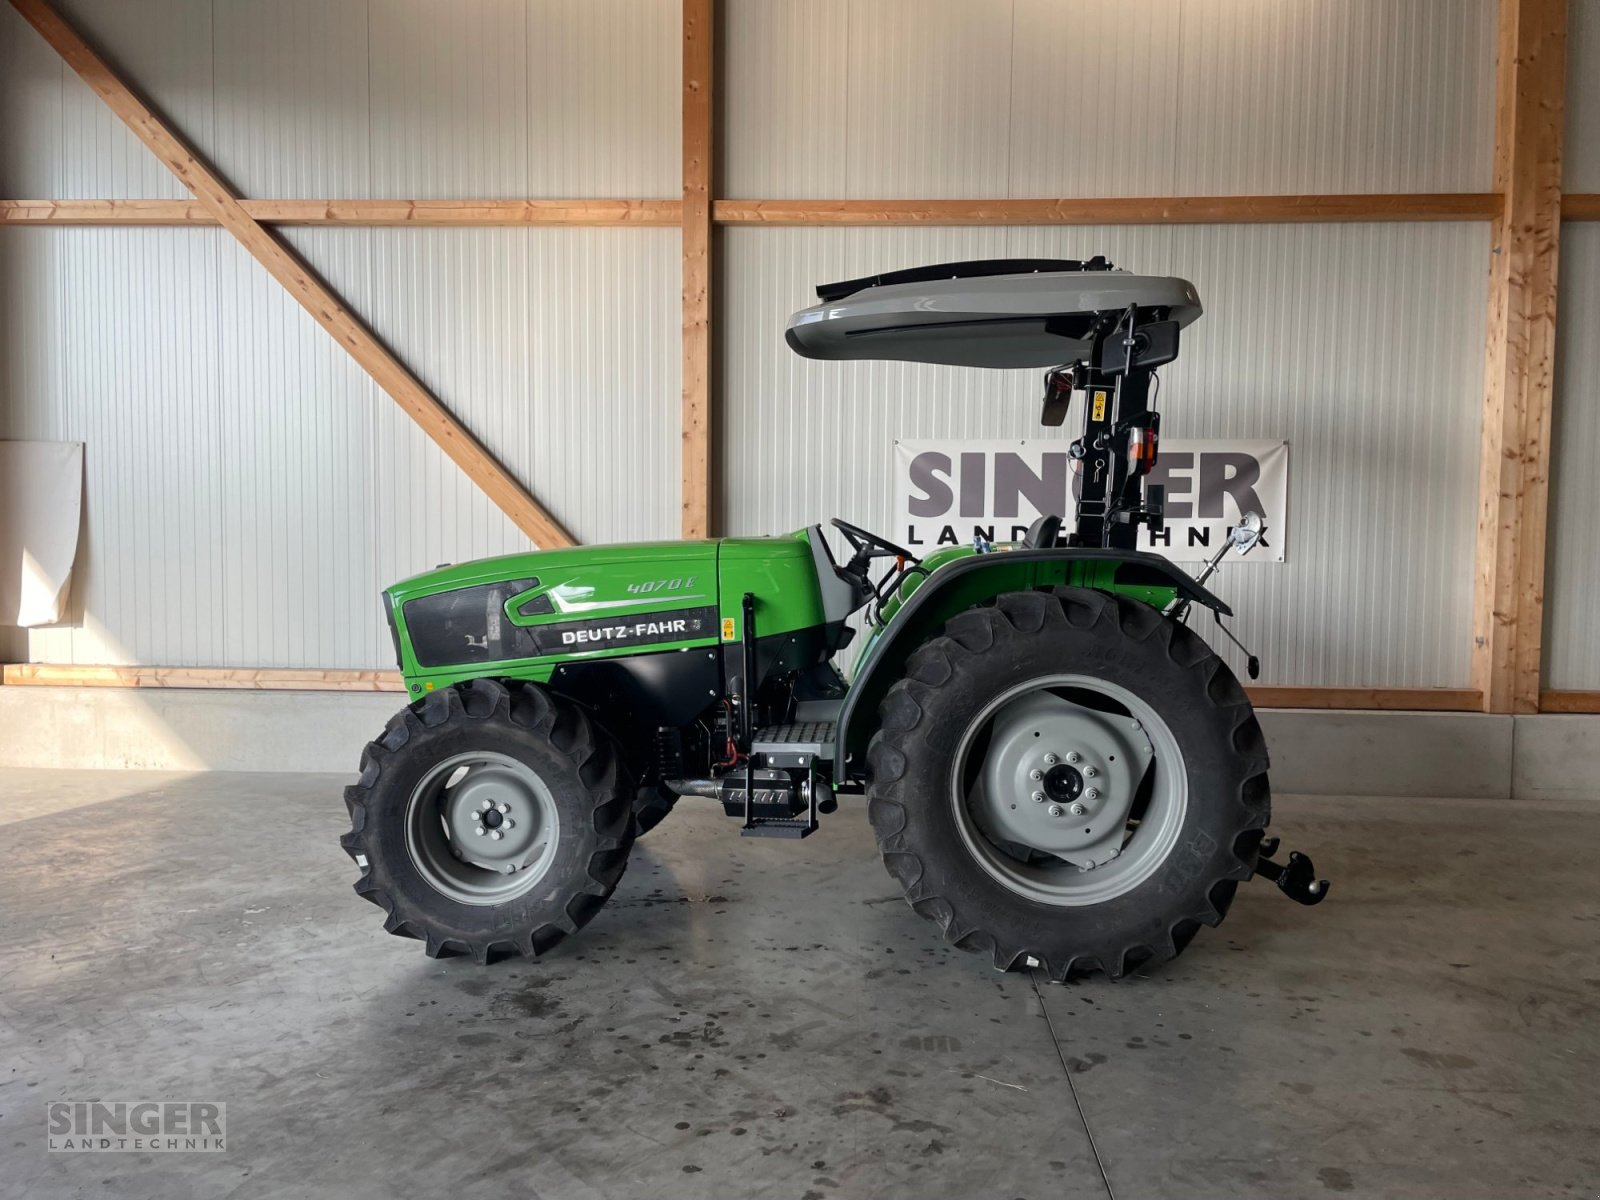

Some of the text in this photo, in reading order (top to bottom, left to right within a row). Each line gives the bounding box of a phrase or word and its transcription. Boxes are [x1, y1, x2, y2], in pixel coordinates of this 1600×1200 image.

[908, 451, 1267, 519] SINER
[626, 576, 698, 594] 4070 E
[561, 619, 686, 645] DEUTZ-FAHR
